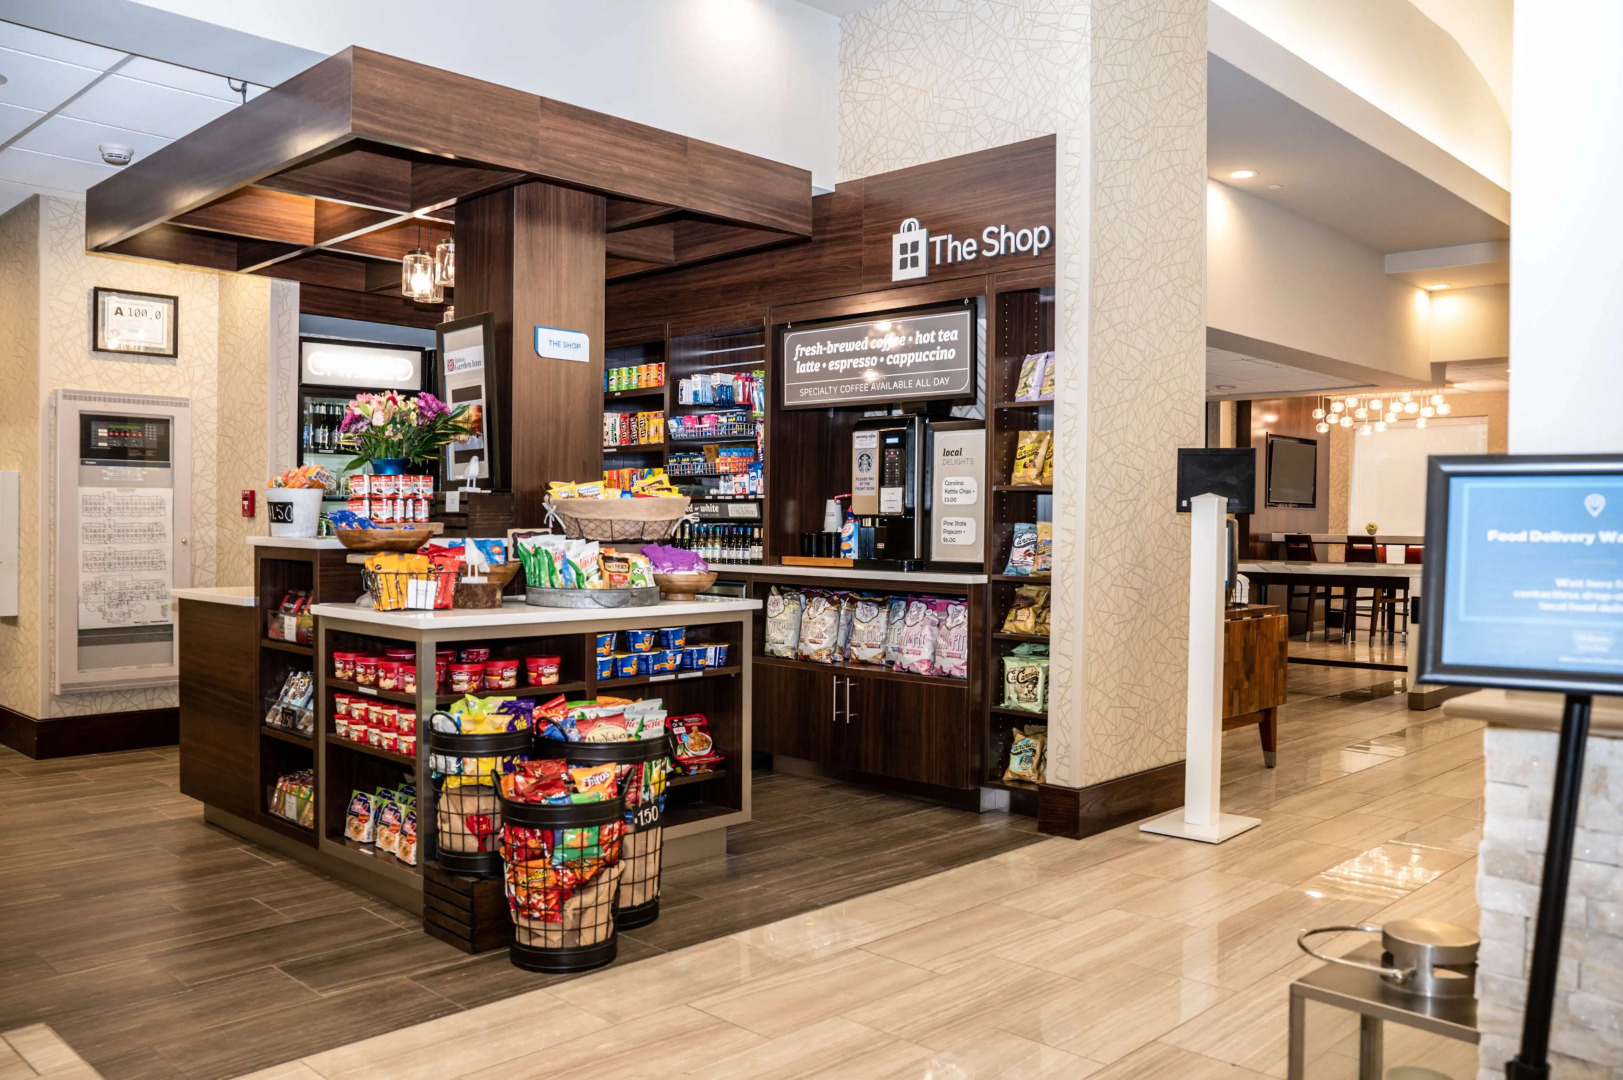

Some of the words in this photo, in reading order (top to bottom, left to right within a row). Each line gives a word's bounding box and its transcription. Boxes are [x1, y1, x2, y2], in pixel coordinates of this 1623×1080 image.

[929, 233, 979, 266] The
[981, 224, 1053, 257] Shop
[114, 307, 124, 317] A
[128, 307, 162, 320] 100.0
[548, 339, 562, 348] THE
[562, 341, 581, 350] SHOP
[793, 337, 869, 361] fresh-brewed
[915, 330, 936, 345] hot
[937, 329, 959, 342] tea
[796, 361, 821, 374] latte
[828, 355, 878, 373] espresso
[886, 345, 956, 368] cappuccino
[799, 386, 838, 397] SPECIALTY
[839, 384, 869, 394] COFFEE
[870, 379, 914, 392] AVAILABLE
[915, 378, 931, 388] ALL
[933, 376, 950, 387] DAY
[943, 448, 963, 457] local
[942, 457, 975, 466] DELIGHTS
[685, 504, 693, 512] ed
[700, 504, 720, 512] white
[1487, 529, 1528, 543] Food
[1529, 530, 1596, 546] Delivery
